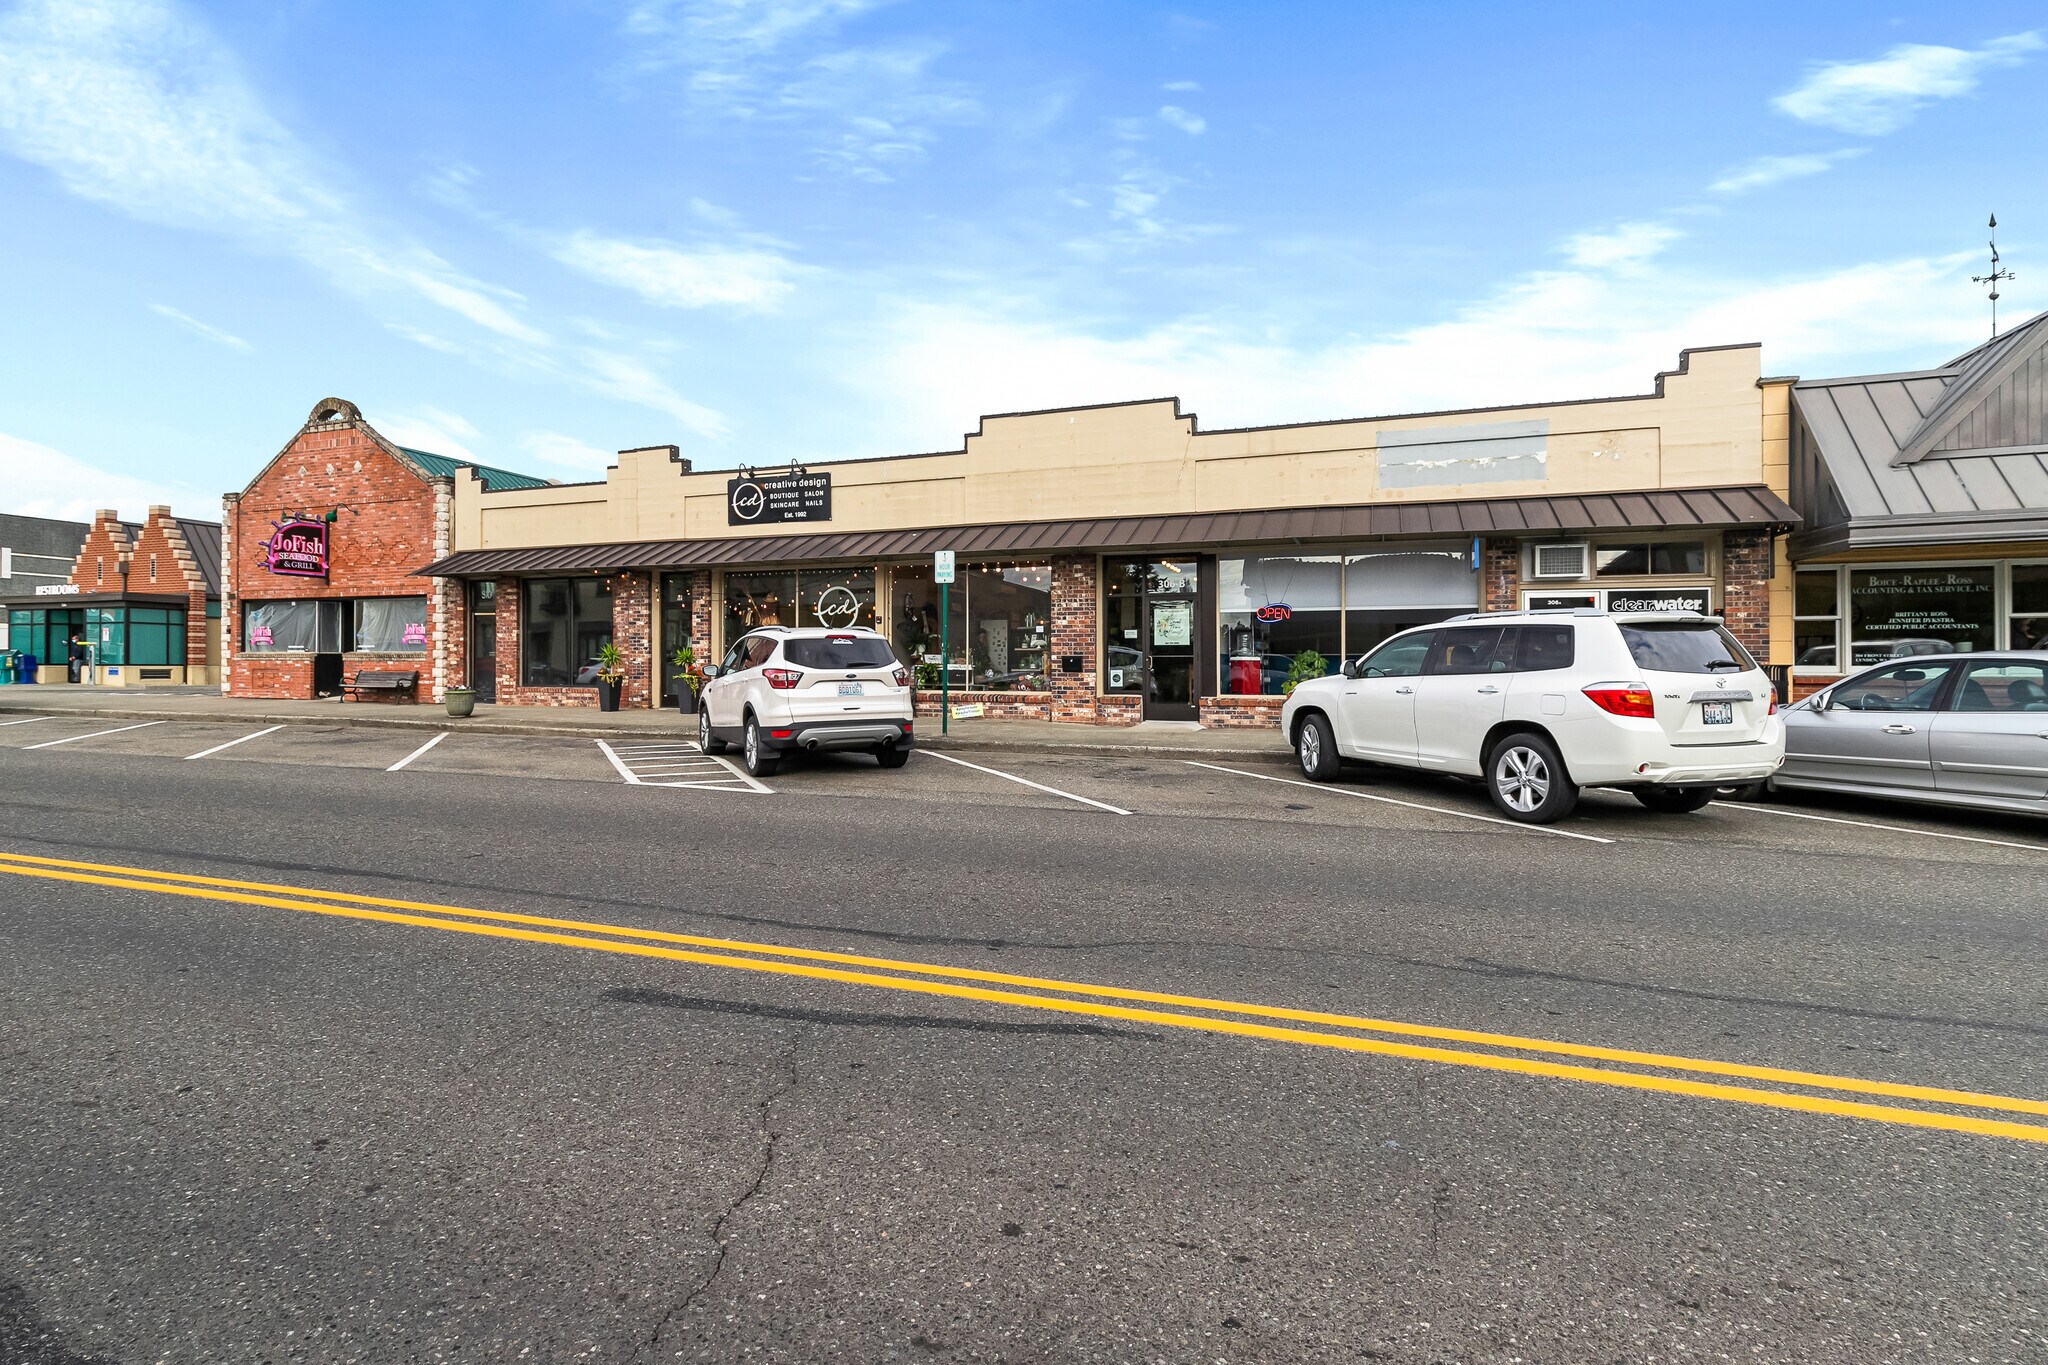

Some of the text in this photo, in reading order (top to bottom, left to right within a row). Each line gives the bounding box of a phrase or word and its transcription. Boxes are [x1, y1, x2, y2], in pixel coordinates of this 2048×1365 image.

[764, 478, 827, 489] creative design
[770, 492, 799, 500] BOUTIQUE
[770, 499, 823, 509] SKINCARE NAILS
[273, 533, 323, 555] JoFish
[279, 552, 319, 563] SEAFOOD
[1256, 607, 1291, 619] OPEN
